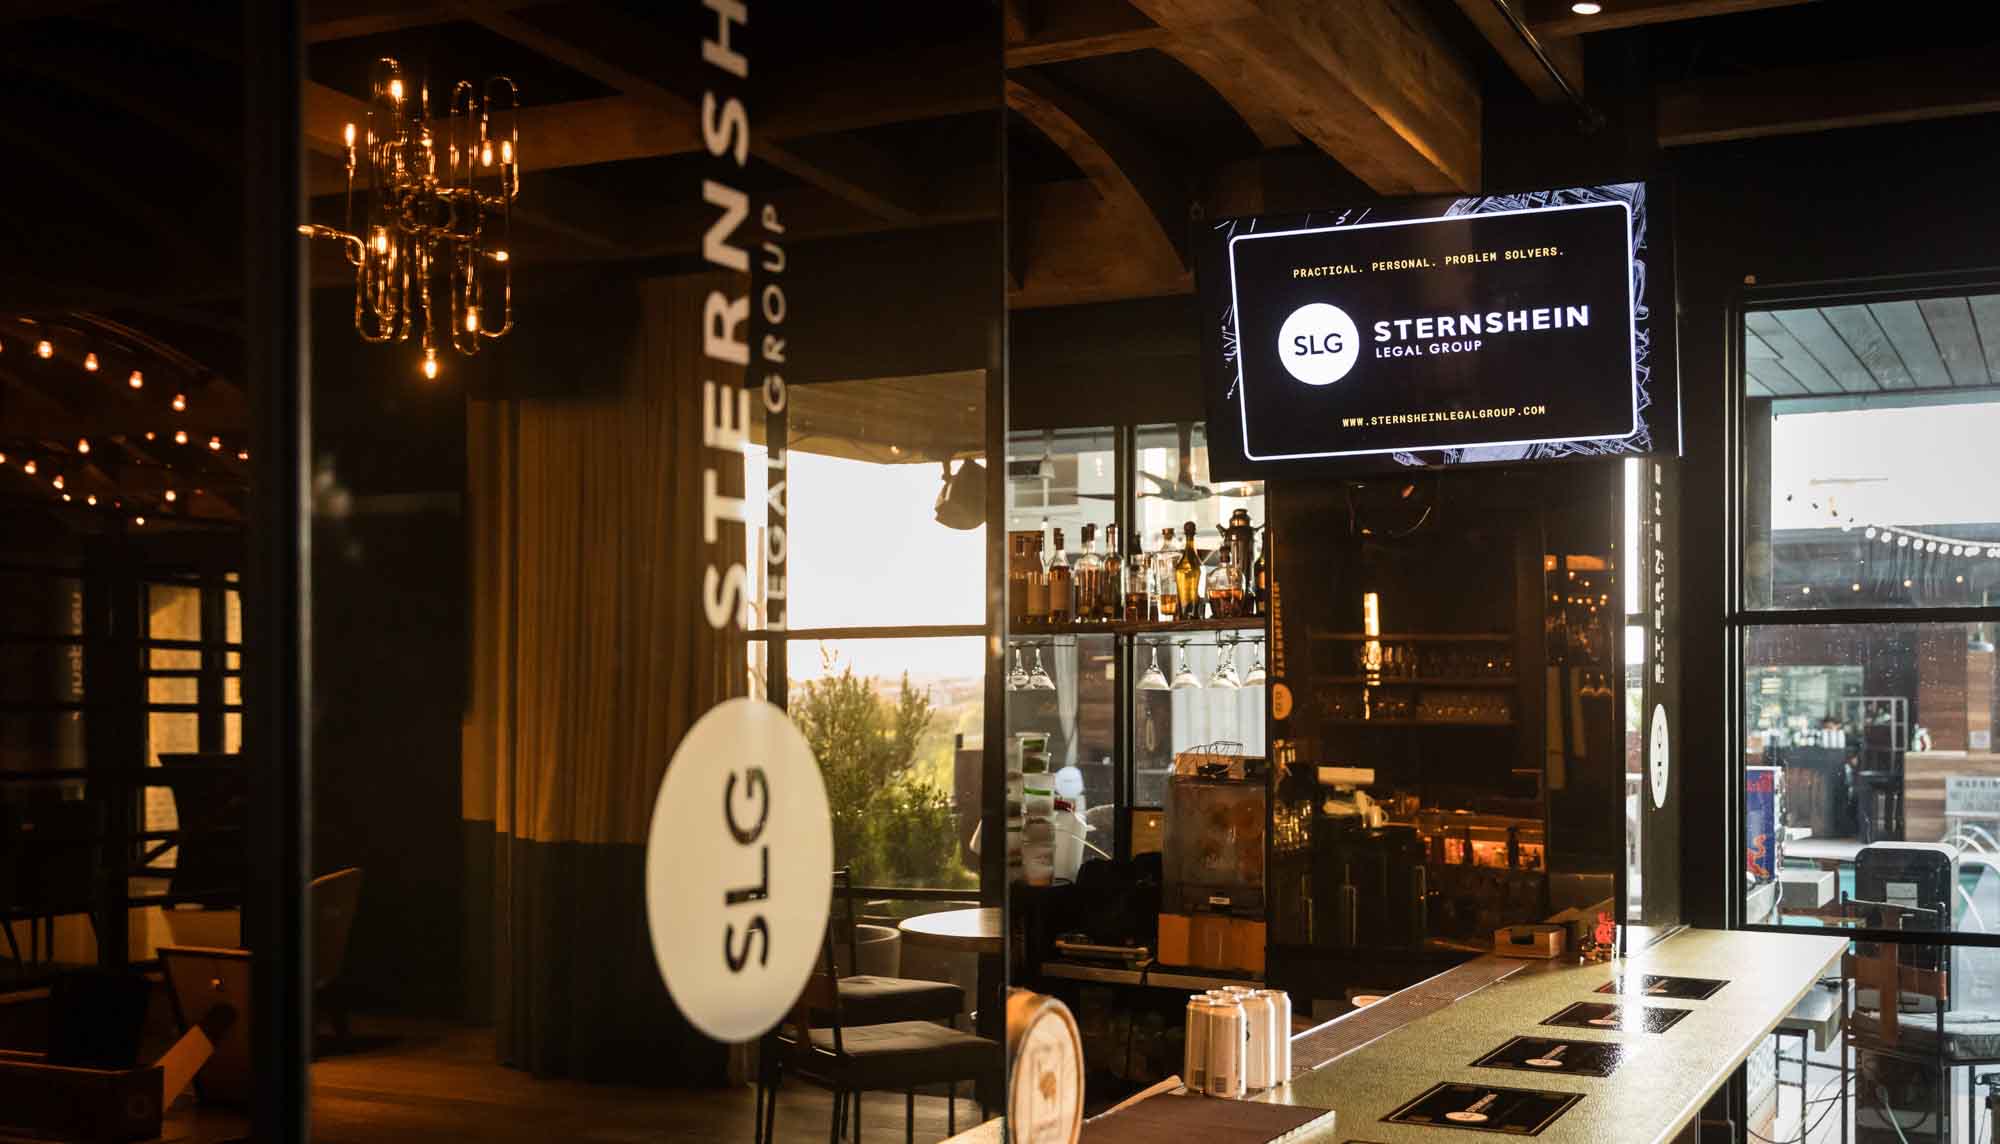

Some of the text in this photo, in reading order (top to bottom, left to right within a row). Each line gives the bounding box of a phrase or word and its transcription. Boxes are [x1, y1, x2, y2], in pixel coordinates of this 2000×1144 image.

[1293, 246, 1564, 279] PRACTICAL. PERSONAL. PROBLEM SOLVERS.
[1373, 304, 1589, 342] STERNSHEIN
[1293, 332, 1343, 357] SLG
[1375, 340, 1482, 359] LEGAL GROUP
[761, 203, 788, 632] LEGAL GROUP
[1342, 405, 1546, 428] WWW.STERNSHEINLEGALGROUP.COM
[723, 767, 769, 973] SLG
